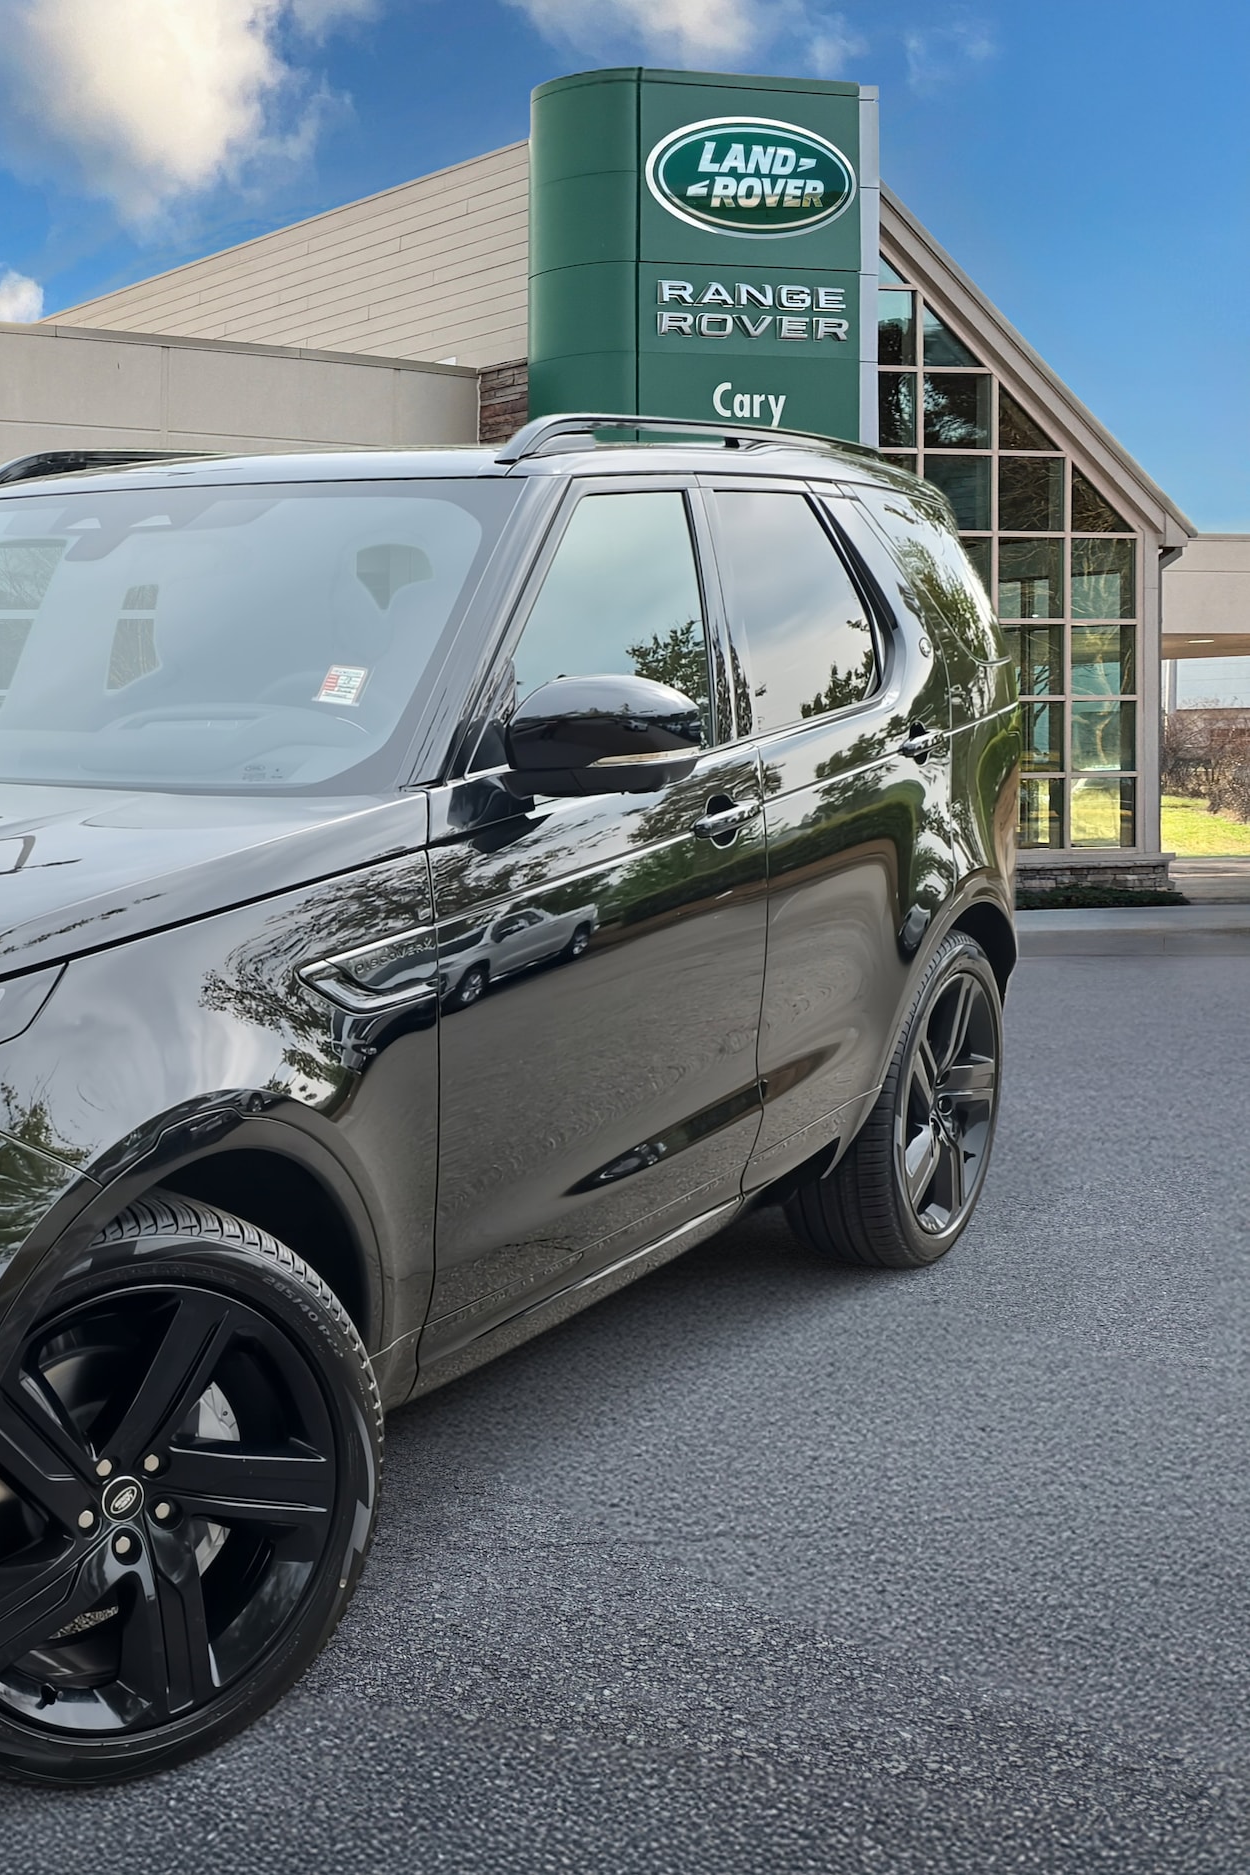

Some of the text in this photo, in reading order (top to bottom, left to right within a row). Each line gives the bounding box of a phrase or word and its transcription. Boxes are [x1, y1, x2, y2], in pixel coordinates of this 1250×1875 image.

[698, 141, 796, 175] LAND
[709, 176, 825, 208] ROVER
[657, 279, 846, 311] RANGE
[657, 312, 849, 342] ROVER
[712, 382, 786, 428] Cary
